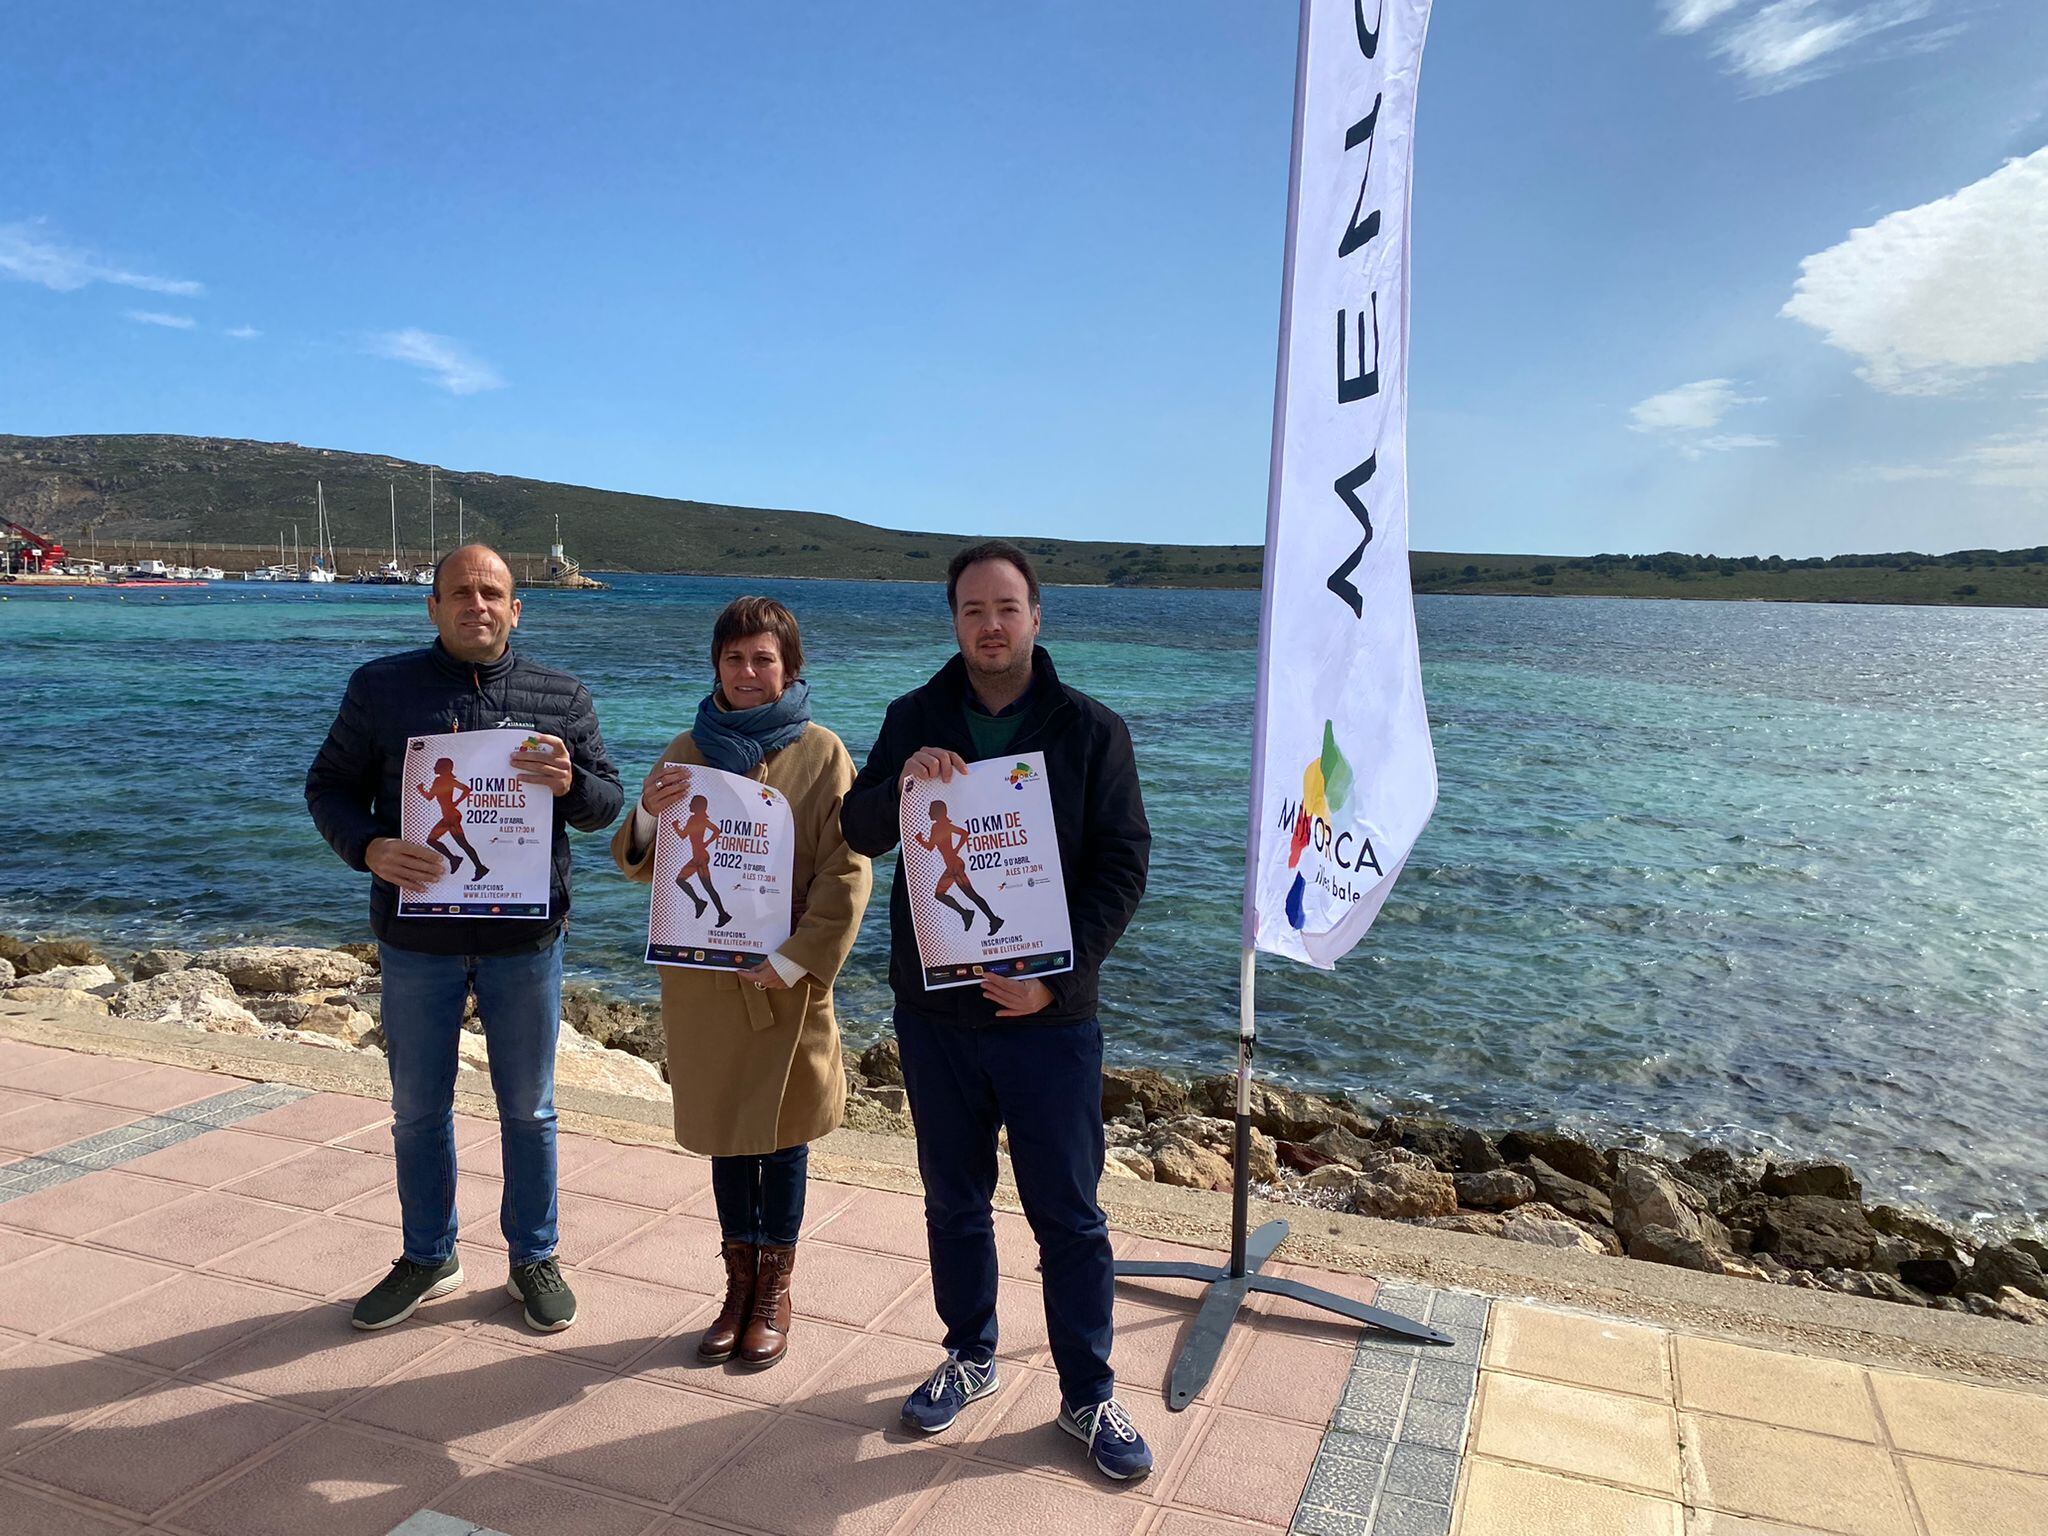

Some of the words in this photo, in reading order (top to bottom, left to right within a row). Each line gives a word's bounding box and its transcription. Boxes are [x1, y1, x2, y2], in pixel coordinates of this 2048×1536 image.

[469, 777, 483, 792] 10
[486, 778, 505, 792] KM
[508, 778, 523, 792] DE
[467, 794, 526, 808] FORNELLS
[466, 810, 498, 824] 2022
[964, 818, 980, 834] 10
[981, 814, 1003, 832] KM
[1004, 811, 1022, 829] DE
[719, 819, 732, 834] 10
[733, 820, 752, 836] KM
[754, 822, 768, 838] DE
[715, 835, 770, 855] FORNELLS
[966, 829, 1028, 853] FORNELLS
[713, 852, 743, 869] 2022
[968, 851, 1002, 871] 2022
[1009, 856, 1031, 865] D'ABRIL
[1010, 867, 1021, 876] LES
[1332, 875, 1361, 903] bale
[707, 929, 747, 939] INSCRIPCIONS
[981, 934, 1023, 948] INSCRIPCIONS
[981, 940, 1044, 956] WWW.ELITECHIP.NET
